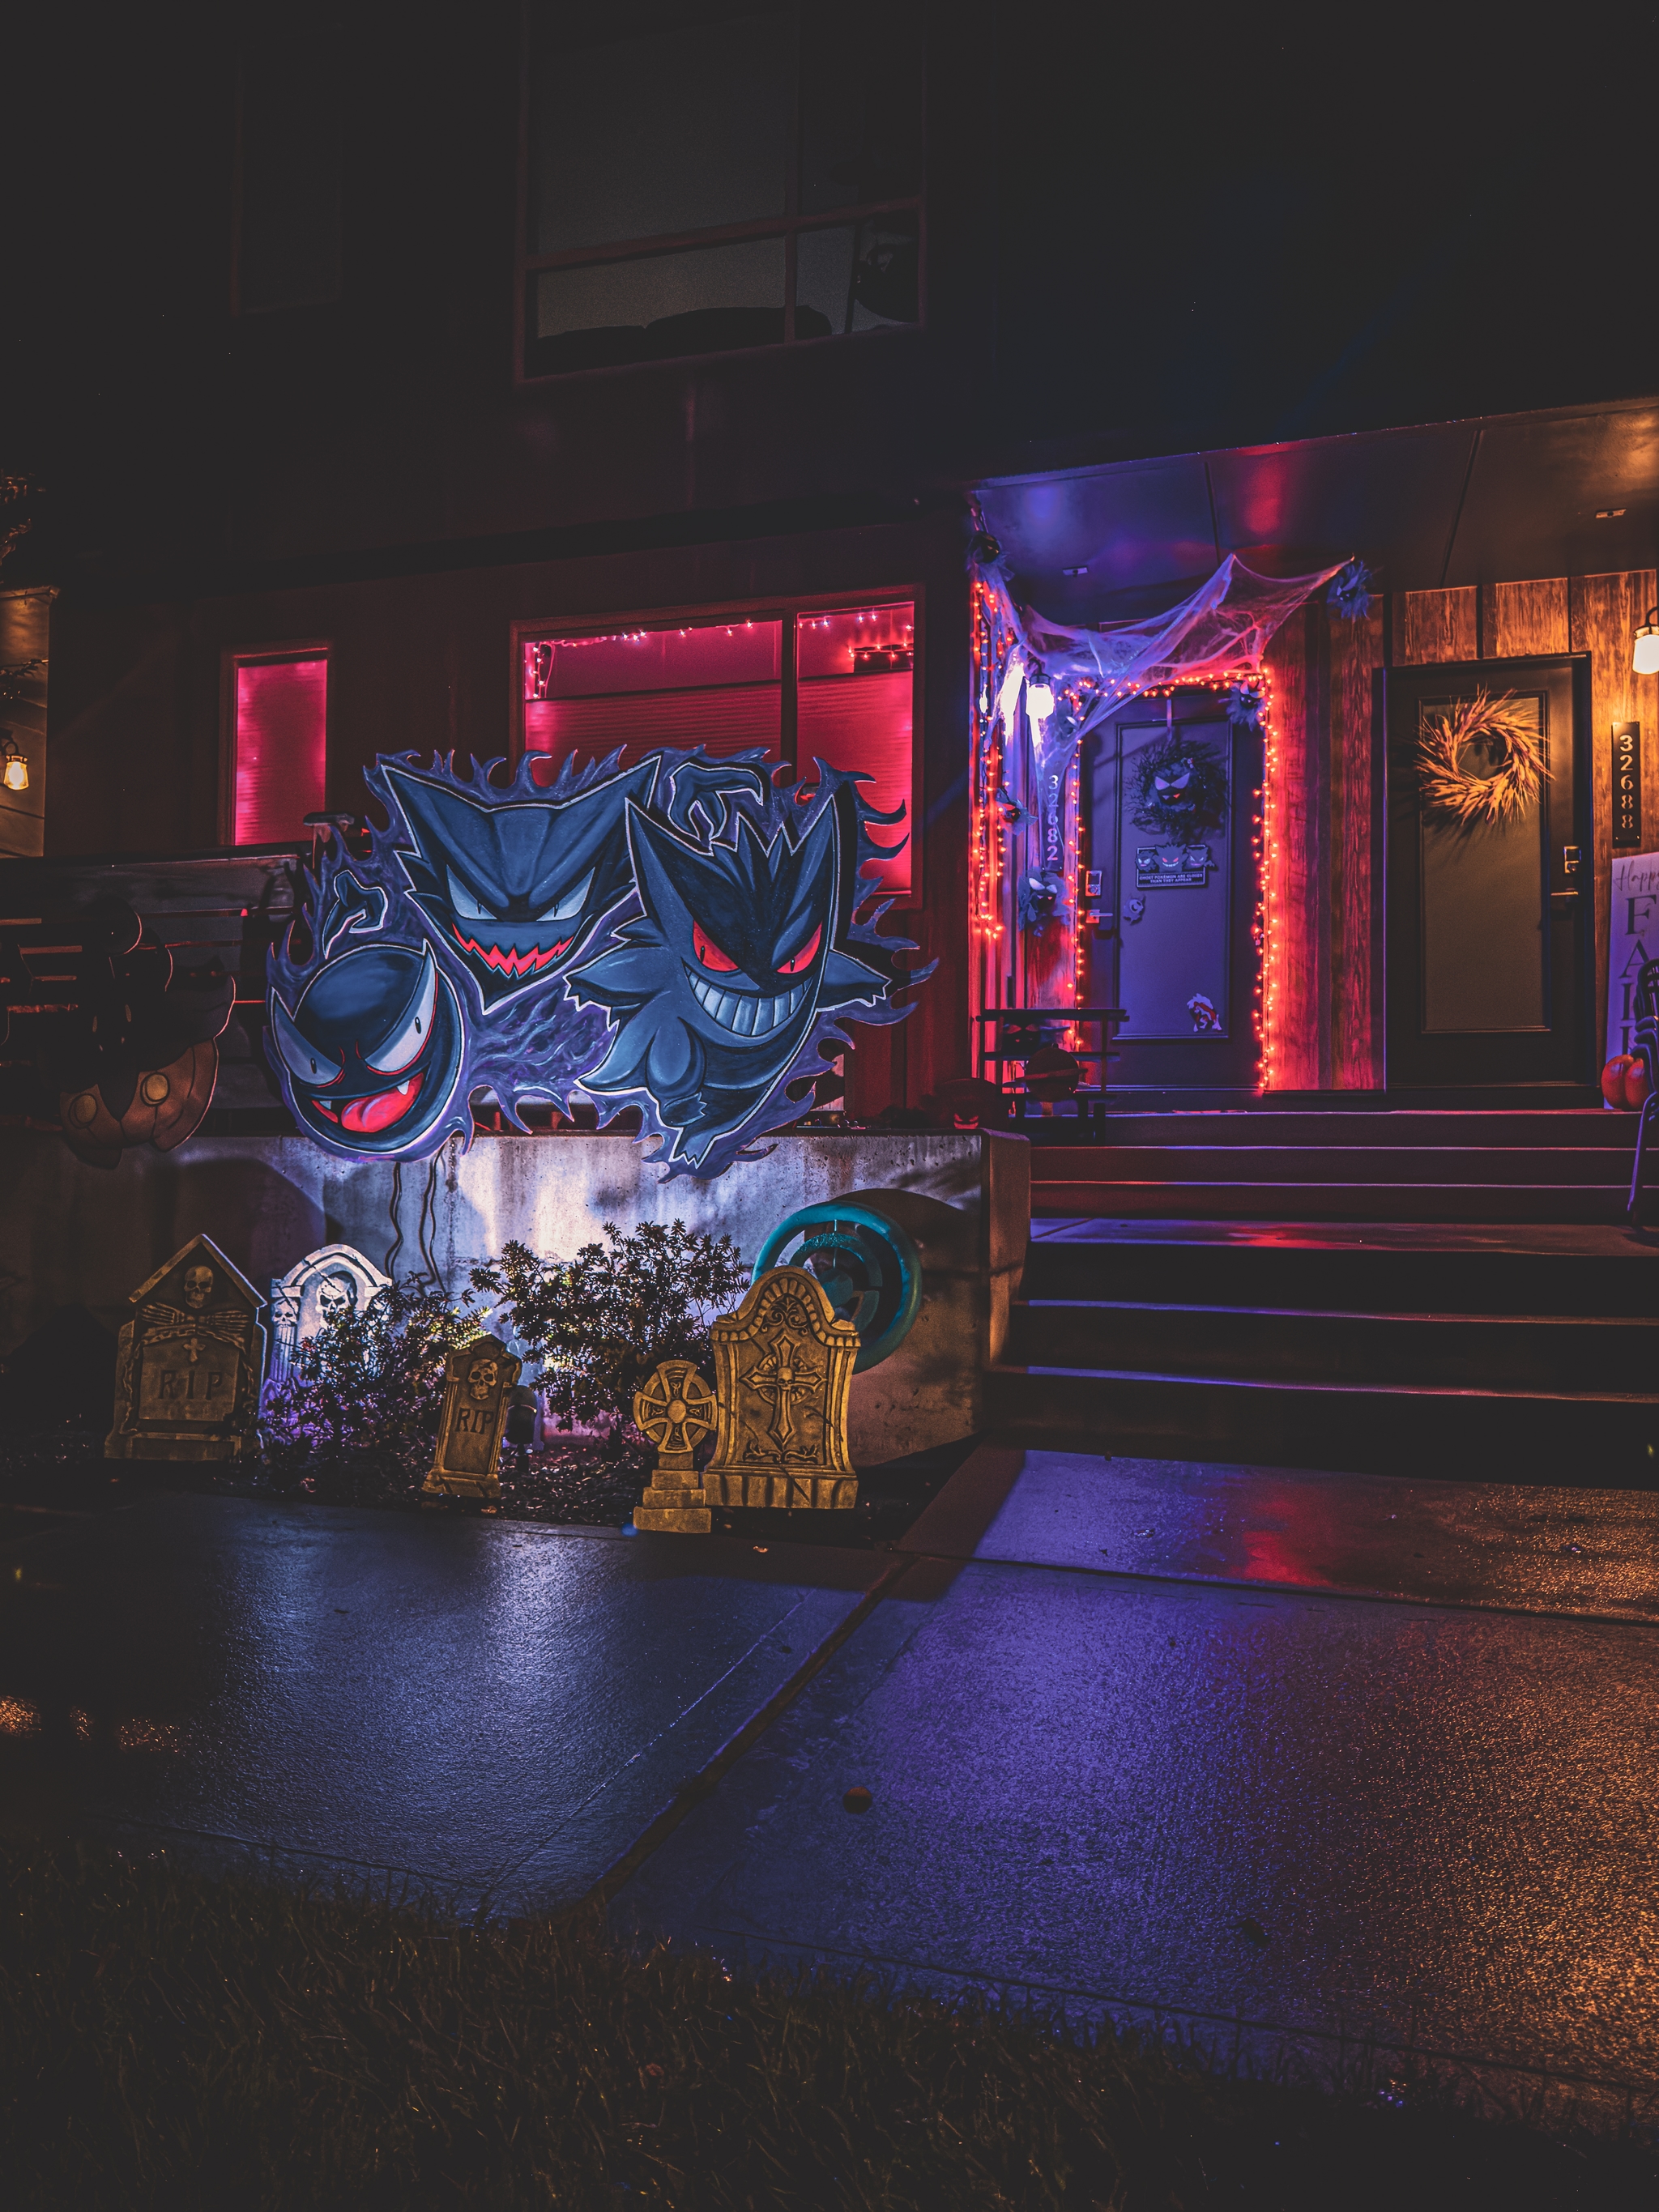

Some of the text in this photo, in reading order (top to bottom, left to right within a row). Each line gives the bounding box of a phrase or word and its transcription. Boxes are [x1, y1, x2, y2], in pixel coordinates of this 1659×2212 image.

[1619, 734, 1635, 829] 32688
[1047, 774, 1060, 862] 32682
[158, 1370, 223, 1400] RIP
[455, 1407, 494, 1434] RIP
